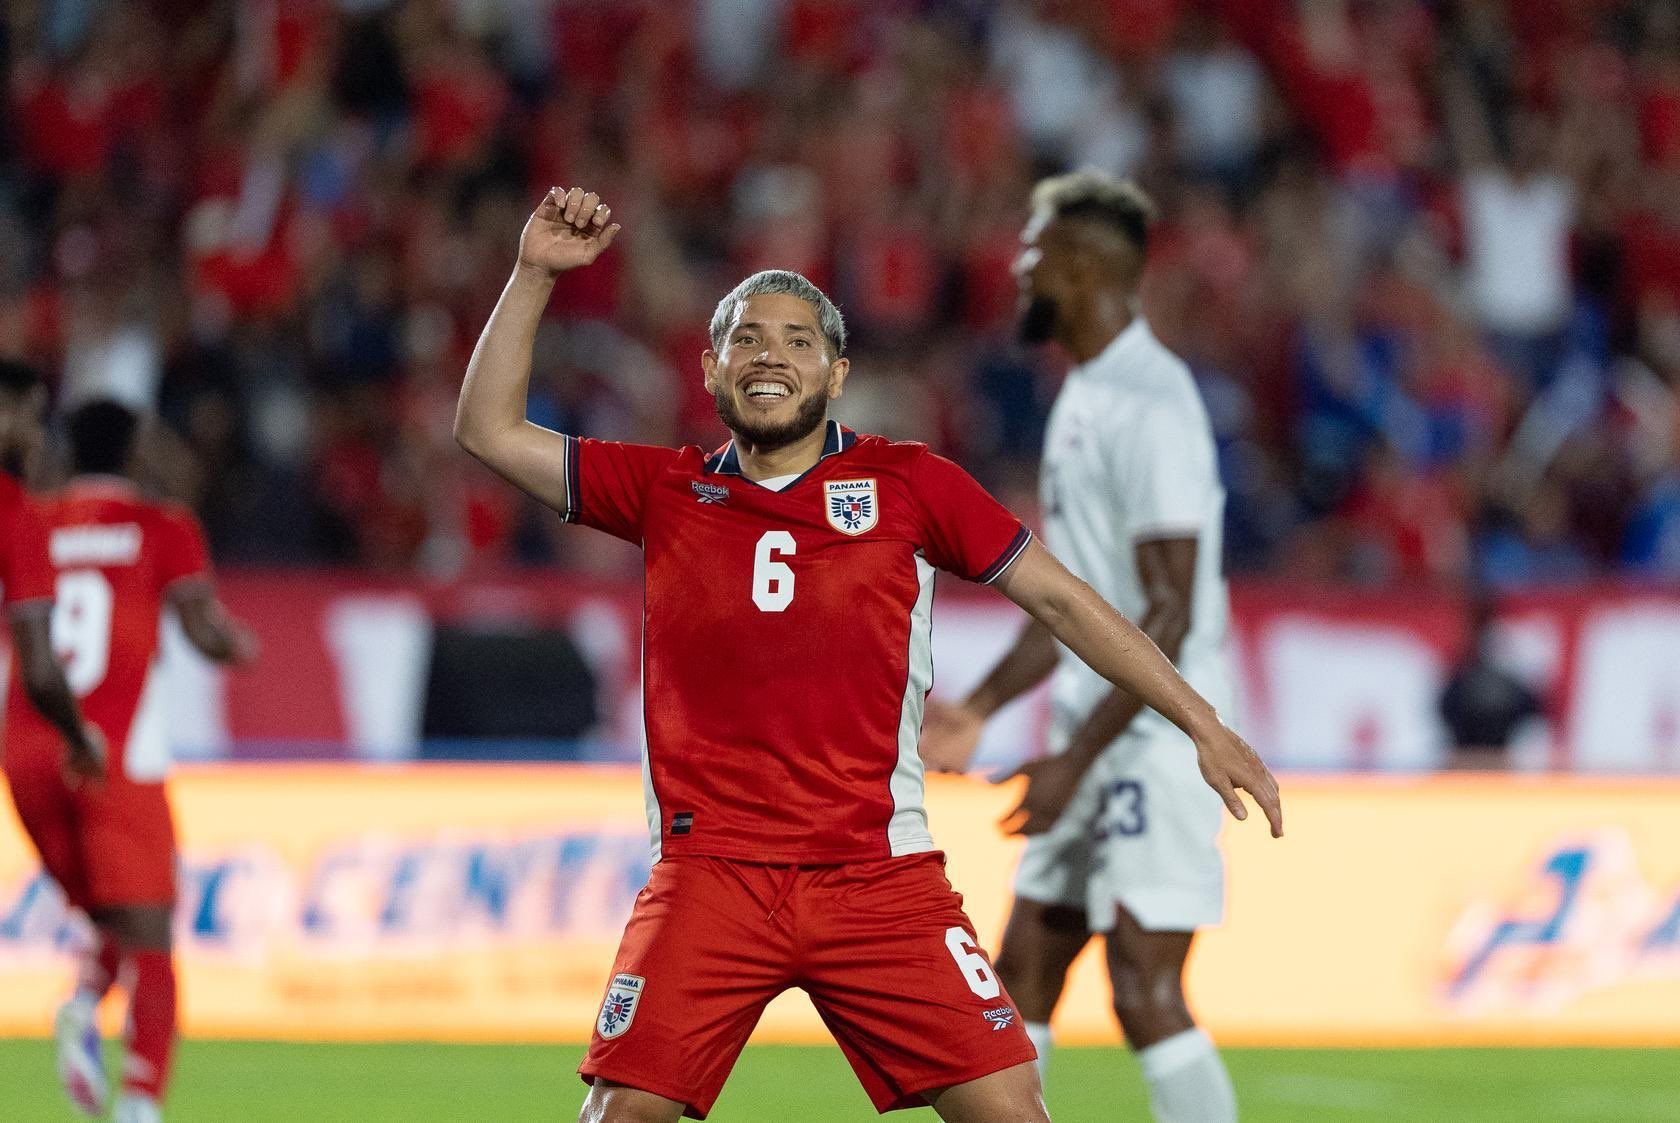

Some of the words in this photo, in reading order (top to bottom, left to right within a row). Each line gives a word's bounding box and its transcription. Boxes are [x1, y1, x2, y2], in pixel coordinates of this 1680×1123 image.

[691, 480, 730, 497] Reebok
[752, 530, 797, 612] 6
[50, 567, 114, 698] 9
[945, 926, 1000, 1000] 6
